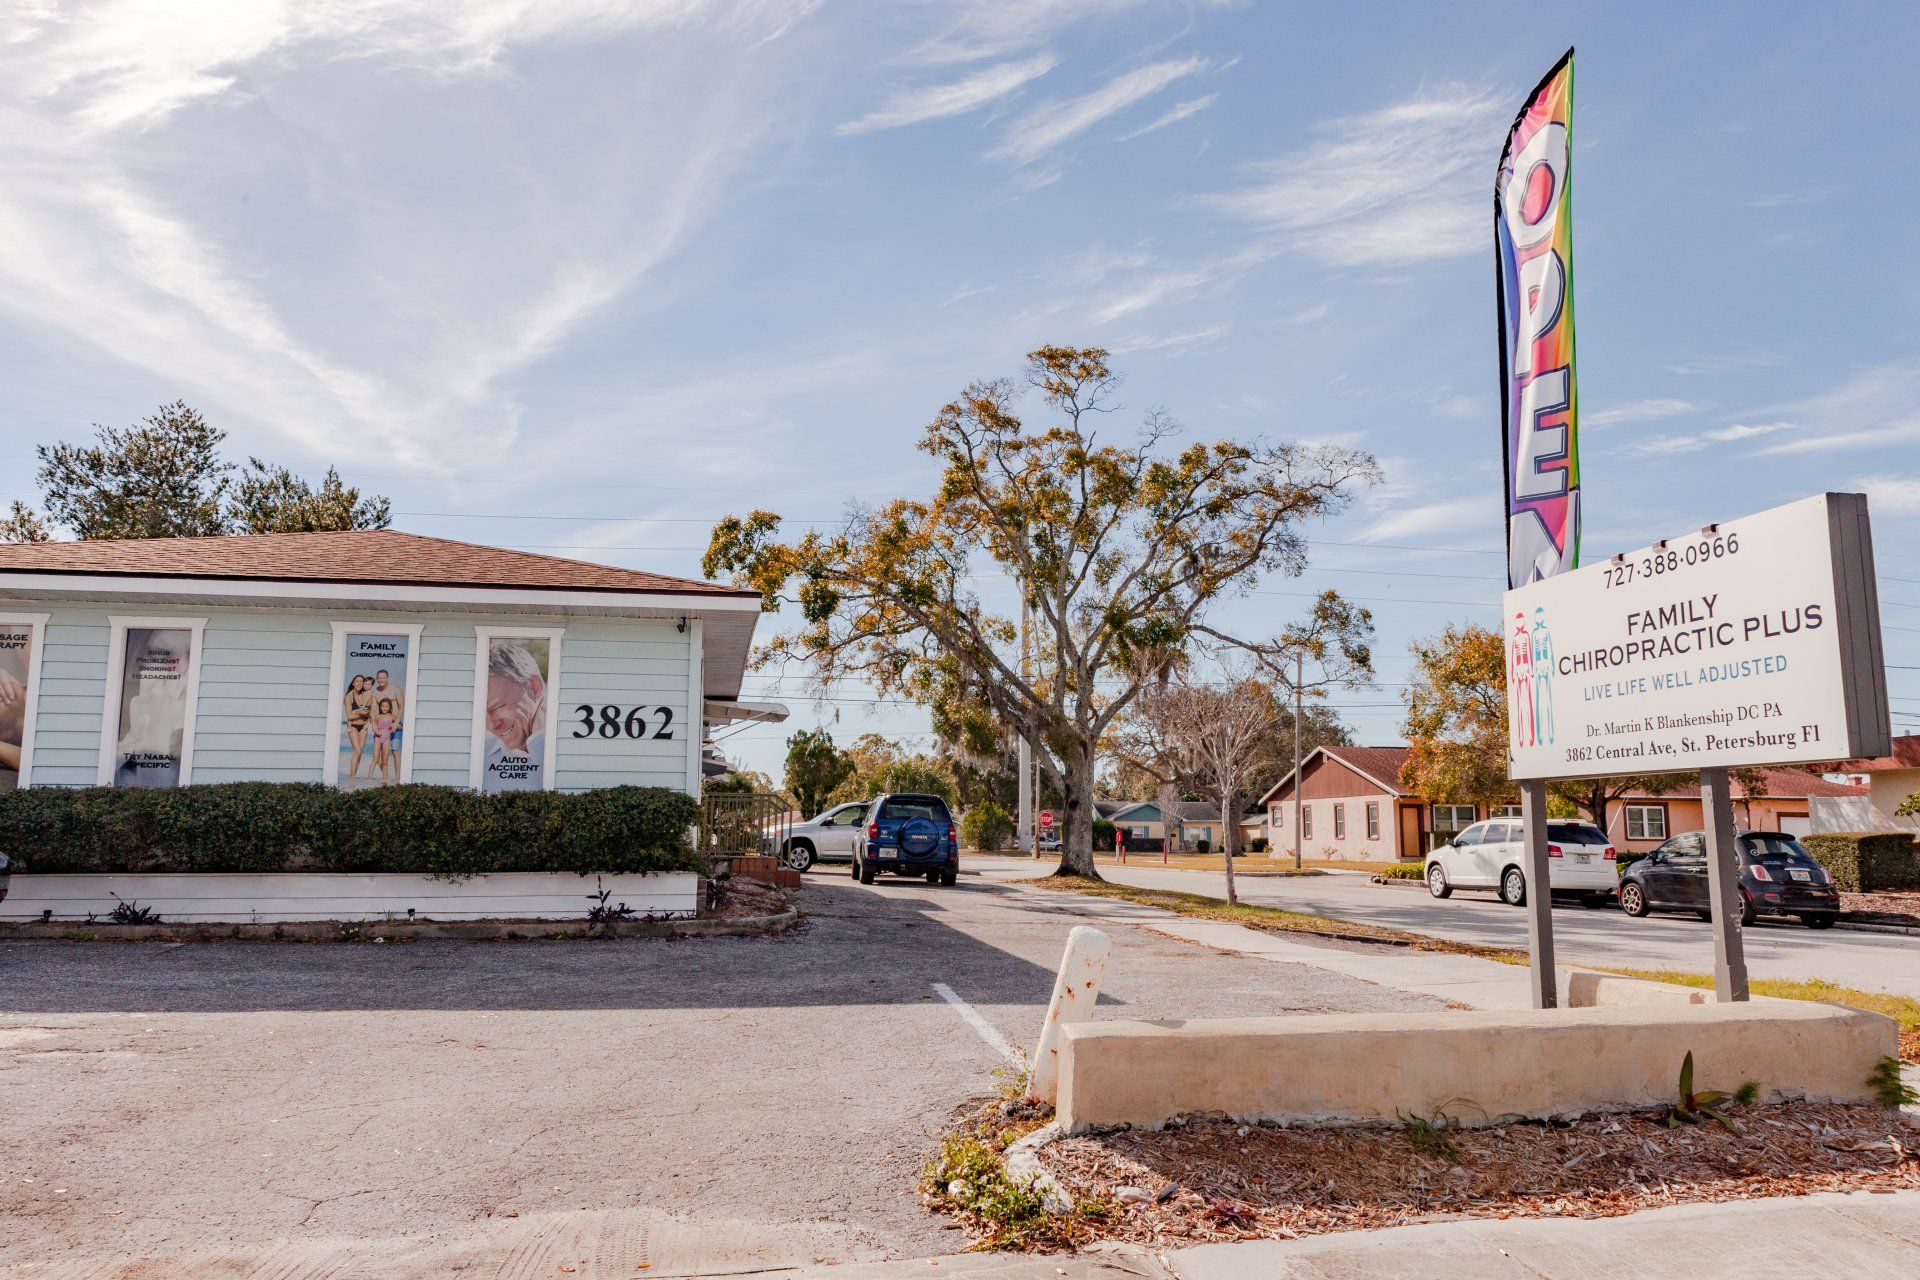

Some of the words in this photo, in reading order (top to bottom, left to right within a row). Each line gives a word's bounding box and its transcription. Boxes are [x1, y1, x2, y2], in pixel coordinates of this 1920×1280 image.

[1627, 593, 1718, 635] FAMILY
[360, 642, 396, 650] FAMILY
[1558, 622, 1734, 676] CHIROPRACTIC
[1743, 604, 1823, 641] PLUS
[1584, 683, 1612, 701] LIVE
[1617, 677, 1646, 695] LIFE
[1652, 670, 1692, 690] WELL
[1699, 654, 1787, 684] ADJUSTED
[572, 704, 673, 740] 3862
[1586, 724, 1601, 737] Dr.
[1604, 719, 1641, 735] Martin
[1644, 718, 1655, 731] K
[1657, 709, 1734, 730] Blankenship
[1737, 704, 1759, 720] DC
[1763, 702, 1782, 718] PA
[144, 753, 176, 761] NASAL
[501, 756, 528, 764] AUTO
[1565, 746, 1592, 762] 3862
[1596, 742, 1644, 760] Central
[1648, 740, 1677, 757] Ave,
[1681, 738, 1700, 752] St.
[1706, 730, 1796, 751] Petersburg
[488, 764, 539, 772] ACCIDENT
[500, 771, 527, 779] CARE
